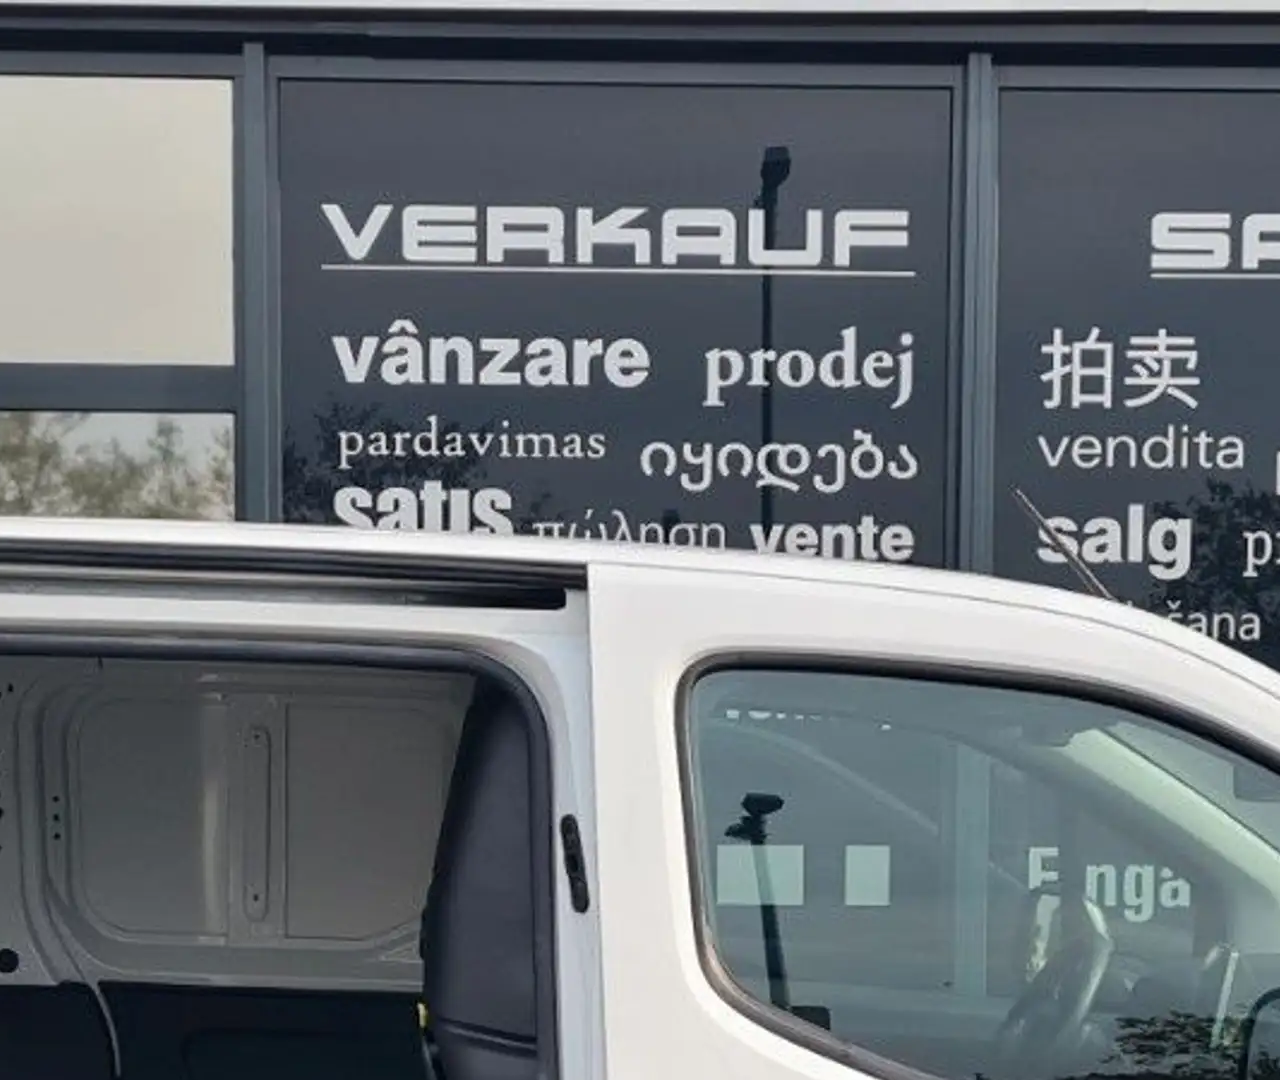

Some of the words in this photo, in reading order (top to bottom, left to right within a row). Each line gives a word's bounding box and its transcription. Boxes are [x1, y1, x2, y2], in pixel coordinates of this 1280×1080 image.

[321, 203, 910, 267] VERKAUF
[332, 319, 650, 387] vânzare
[702, 326, 913, 409] prodej
[1040, 326, 1201, 409] 拍卖
[337, 415, 606, 469] pardavimas
[640, 429, 918, 493] იყიდება
[1038, 424, 1244, 469] vendita
[750, 515, 915, 561] vente
[1037, 504, 1192, 580] salg
